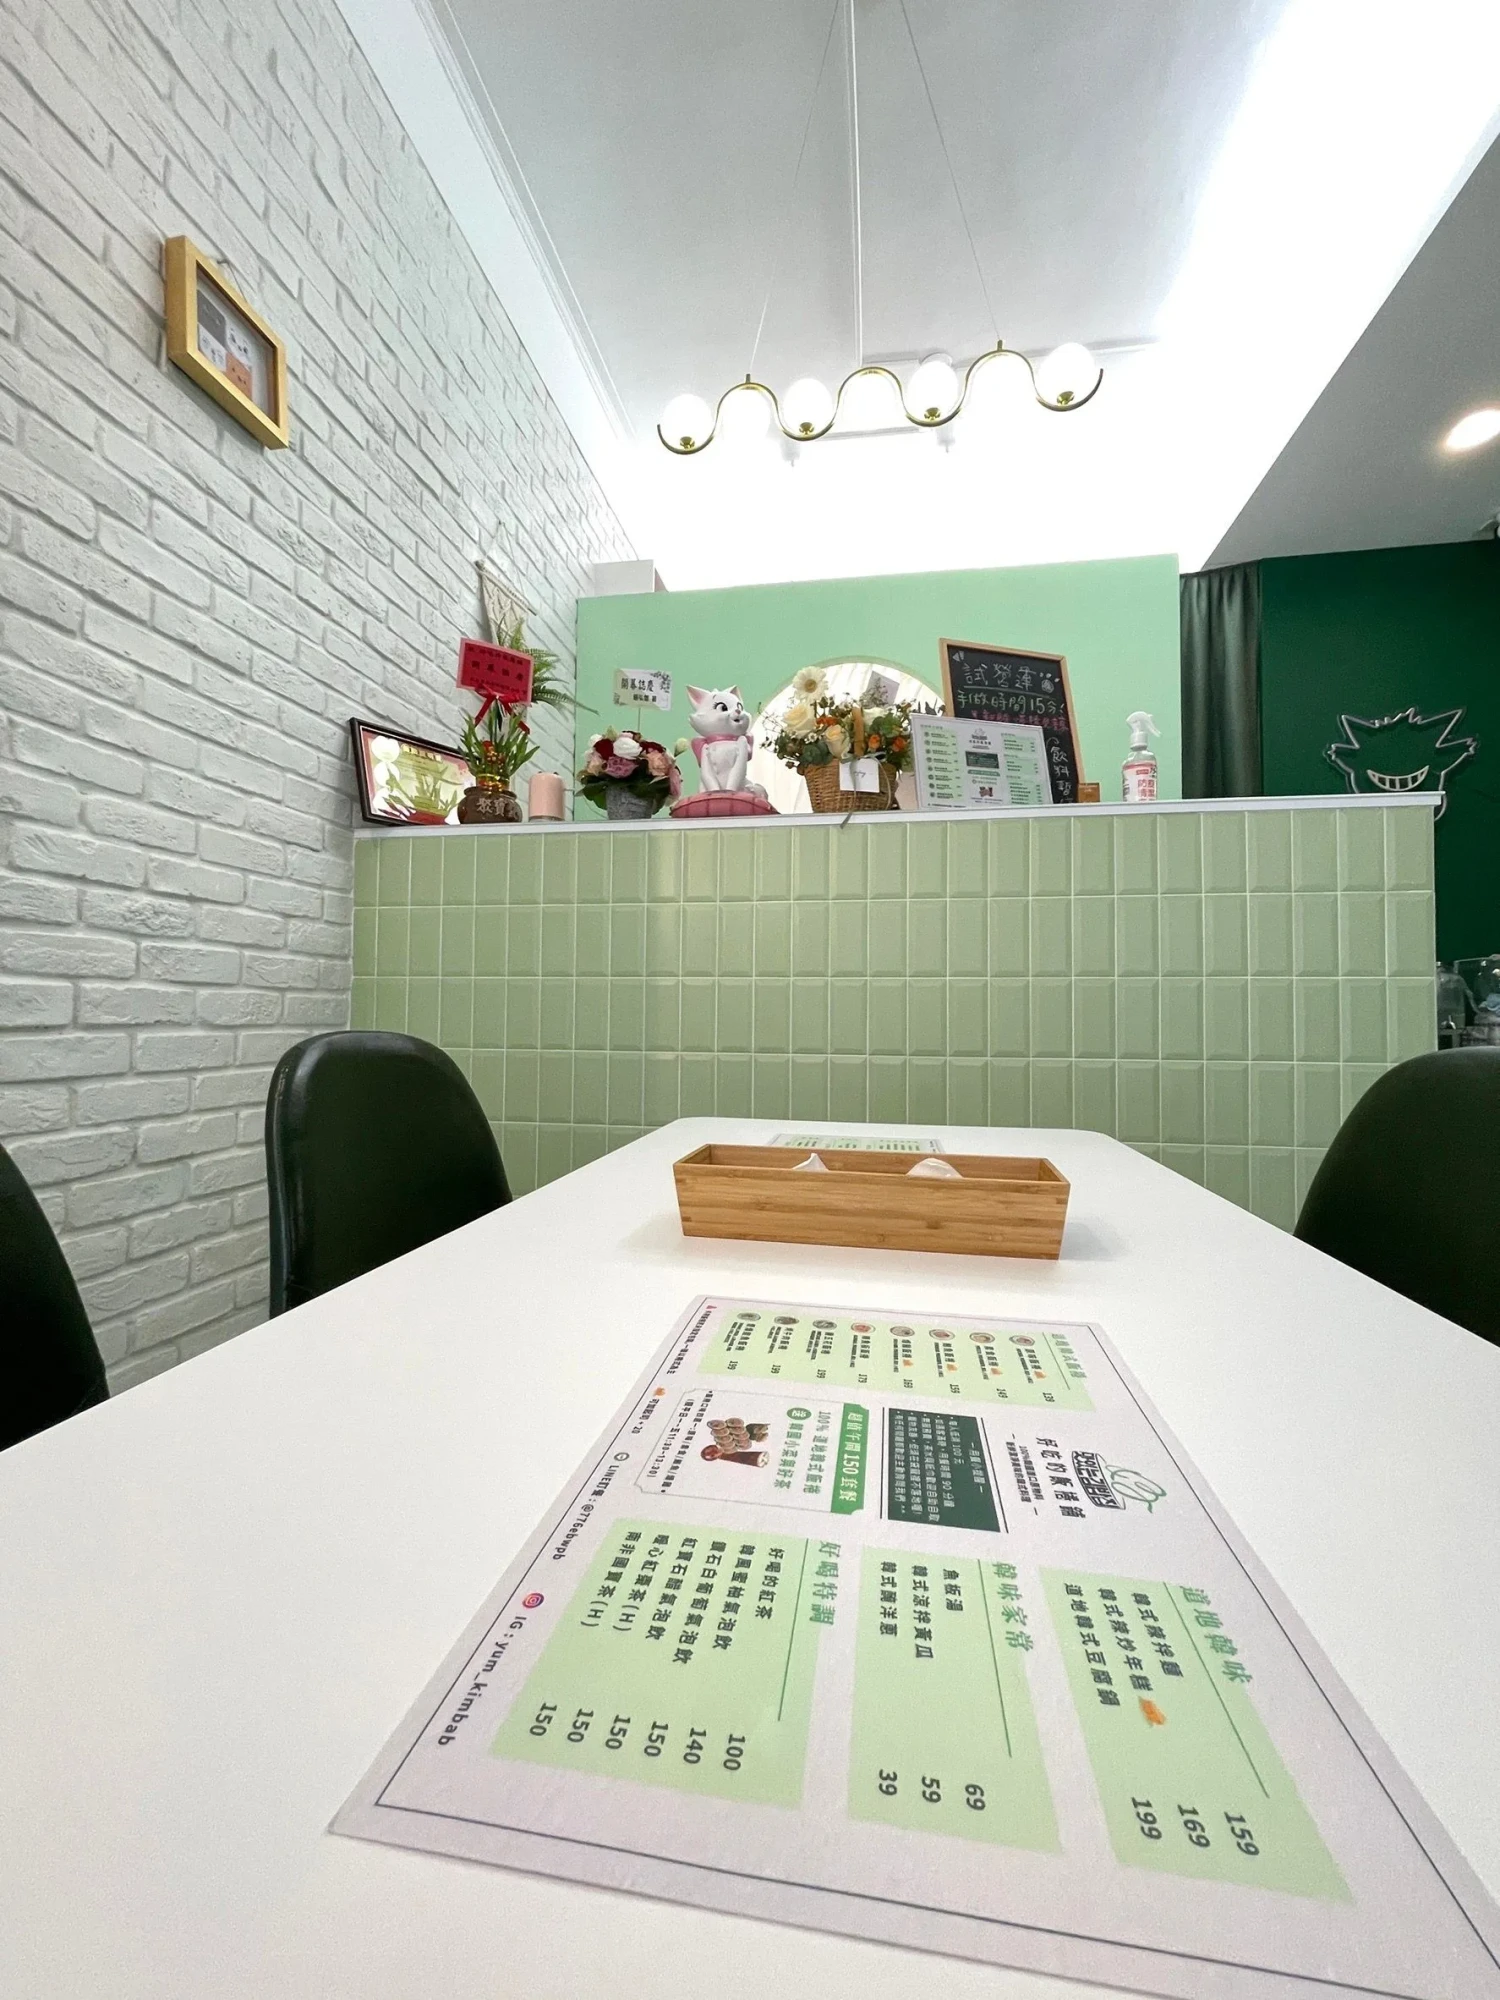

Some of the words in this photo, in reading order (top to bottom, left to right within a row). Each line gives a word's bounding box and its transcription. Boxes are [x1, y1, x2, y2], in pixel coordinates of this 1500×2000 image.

[726, 1360, 738, 1369] 199
[770, 1364, 781, 1373] 199
[816, 1369, 826, 1378] 199
[857, 1373, 867, 1383] 179
[903, 1378, 912, 1388] 169
[949, 1383, 959, 1393] 159
[995, 1388, 1007, 1398] 149
[1042, 1392, 1055, 1402] 139
[815, 1410, 831, 1432] 100%
[841, 1453, 859, 1475] 150
[838, 1476, 858, 1502] 套餐
[753, 1547, 784, 1620] 好喝的紅茶
[807, 1540, 841, 1626] 好喝特調
[991, 1560, 1035, 1652] 韓味家常
[1177, 1585, 1257, 1685] 道地韓味
[429, 1641, 514, 1748] yum_kimbab
[942, 1568, 963, 1612] 魚板湯
[963, 1782, 986, 1812] 69
[526, 1701, 559, 1737] 150
[563, 1707, 595, 1744] 150
[1063, 1583, 1121, 1707] 道地韓式豆腐鍋
[1130, 1796, 1164, 1841] 199
[602, 1713, 632, 1751] 150
[641, 1720, 669, 1758] 150
[680, 1726, 707, 1765] 140
[720, 1732, 746, 1772] 100
[878, 1768, 897, 1797] 39
[921, 1775, 941, 1804] 59
[1175, 1803, 1213, 1850] 169
[1222, 1811, 1262, 1858] 159
